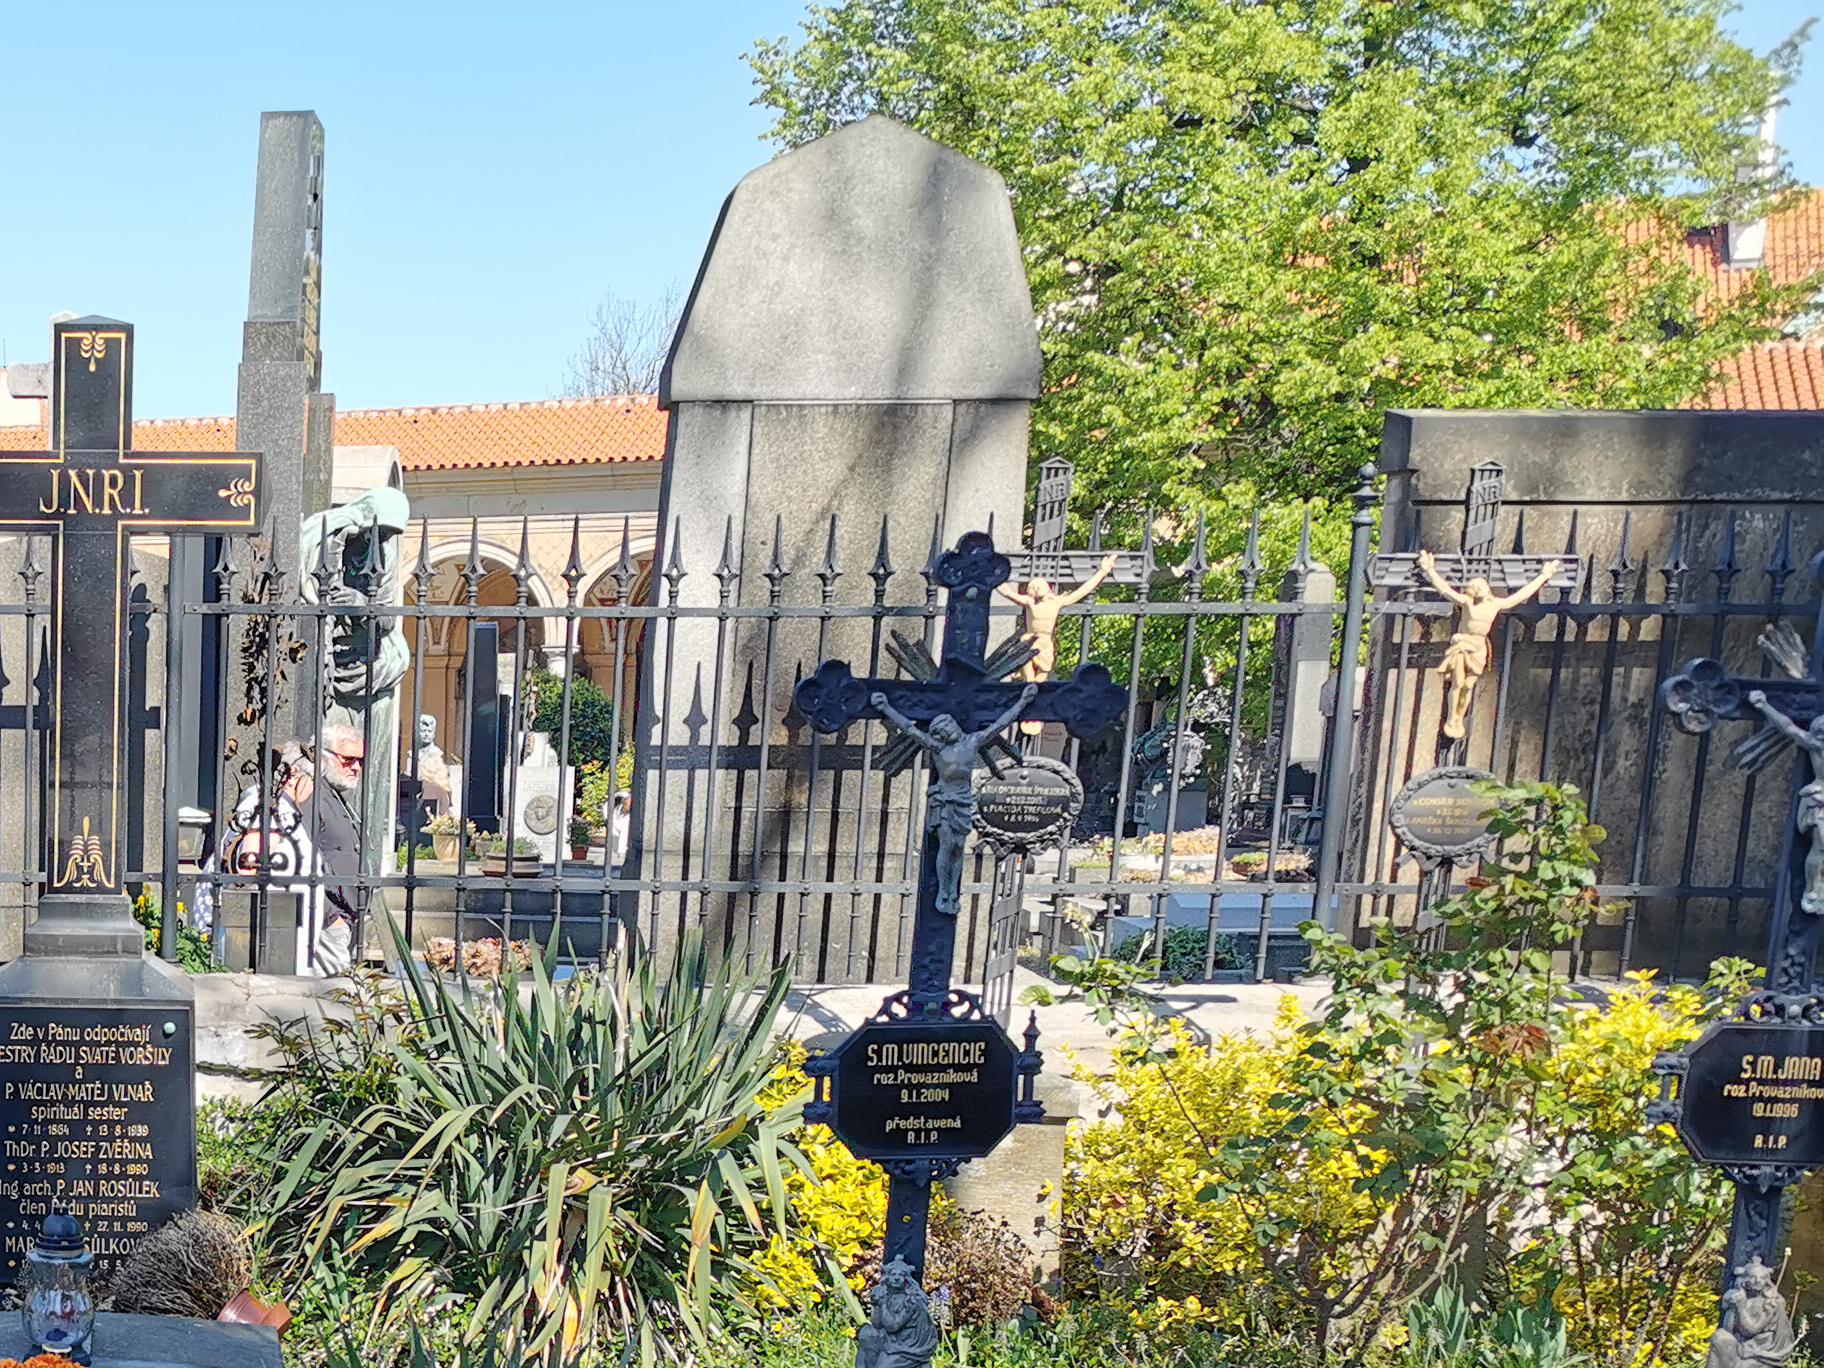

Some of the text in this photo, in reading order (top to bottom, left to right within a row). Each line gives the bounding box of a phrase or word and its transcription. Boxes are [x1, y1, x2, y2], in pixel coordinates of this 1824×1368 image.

[10, 1022, 152, 1044] Zde v Pánu odpočívají
[40, 1042, 75, 1064] ŘÁDU
[79, 1043, 116, 1065] SVATÉ
[119, 1045, 173, 1066] VORŠILY
[75, 1065, 84, 1079] a
[5, 1082, 14, 1100] P.
[112, 1080, 154, 1101] VLNAŘ
[31, 1103, 129, 1122] spirituál sester
[885, 1115, 962, 1133] představená
[53, 1141, 96, 1158] JOSEF
[98, 1138, 154, 1159] ZVĚŘINA
[69, 1180, 94, 1197] JAN
[99, 1177, 160, 1198] ROSŮLEK
[19, 1198, 46, 1216] člen
[88, 1199, 137, 1219] piaristů
